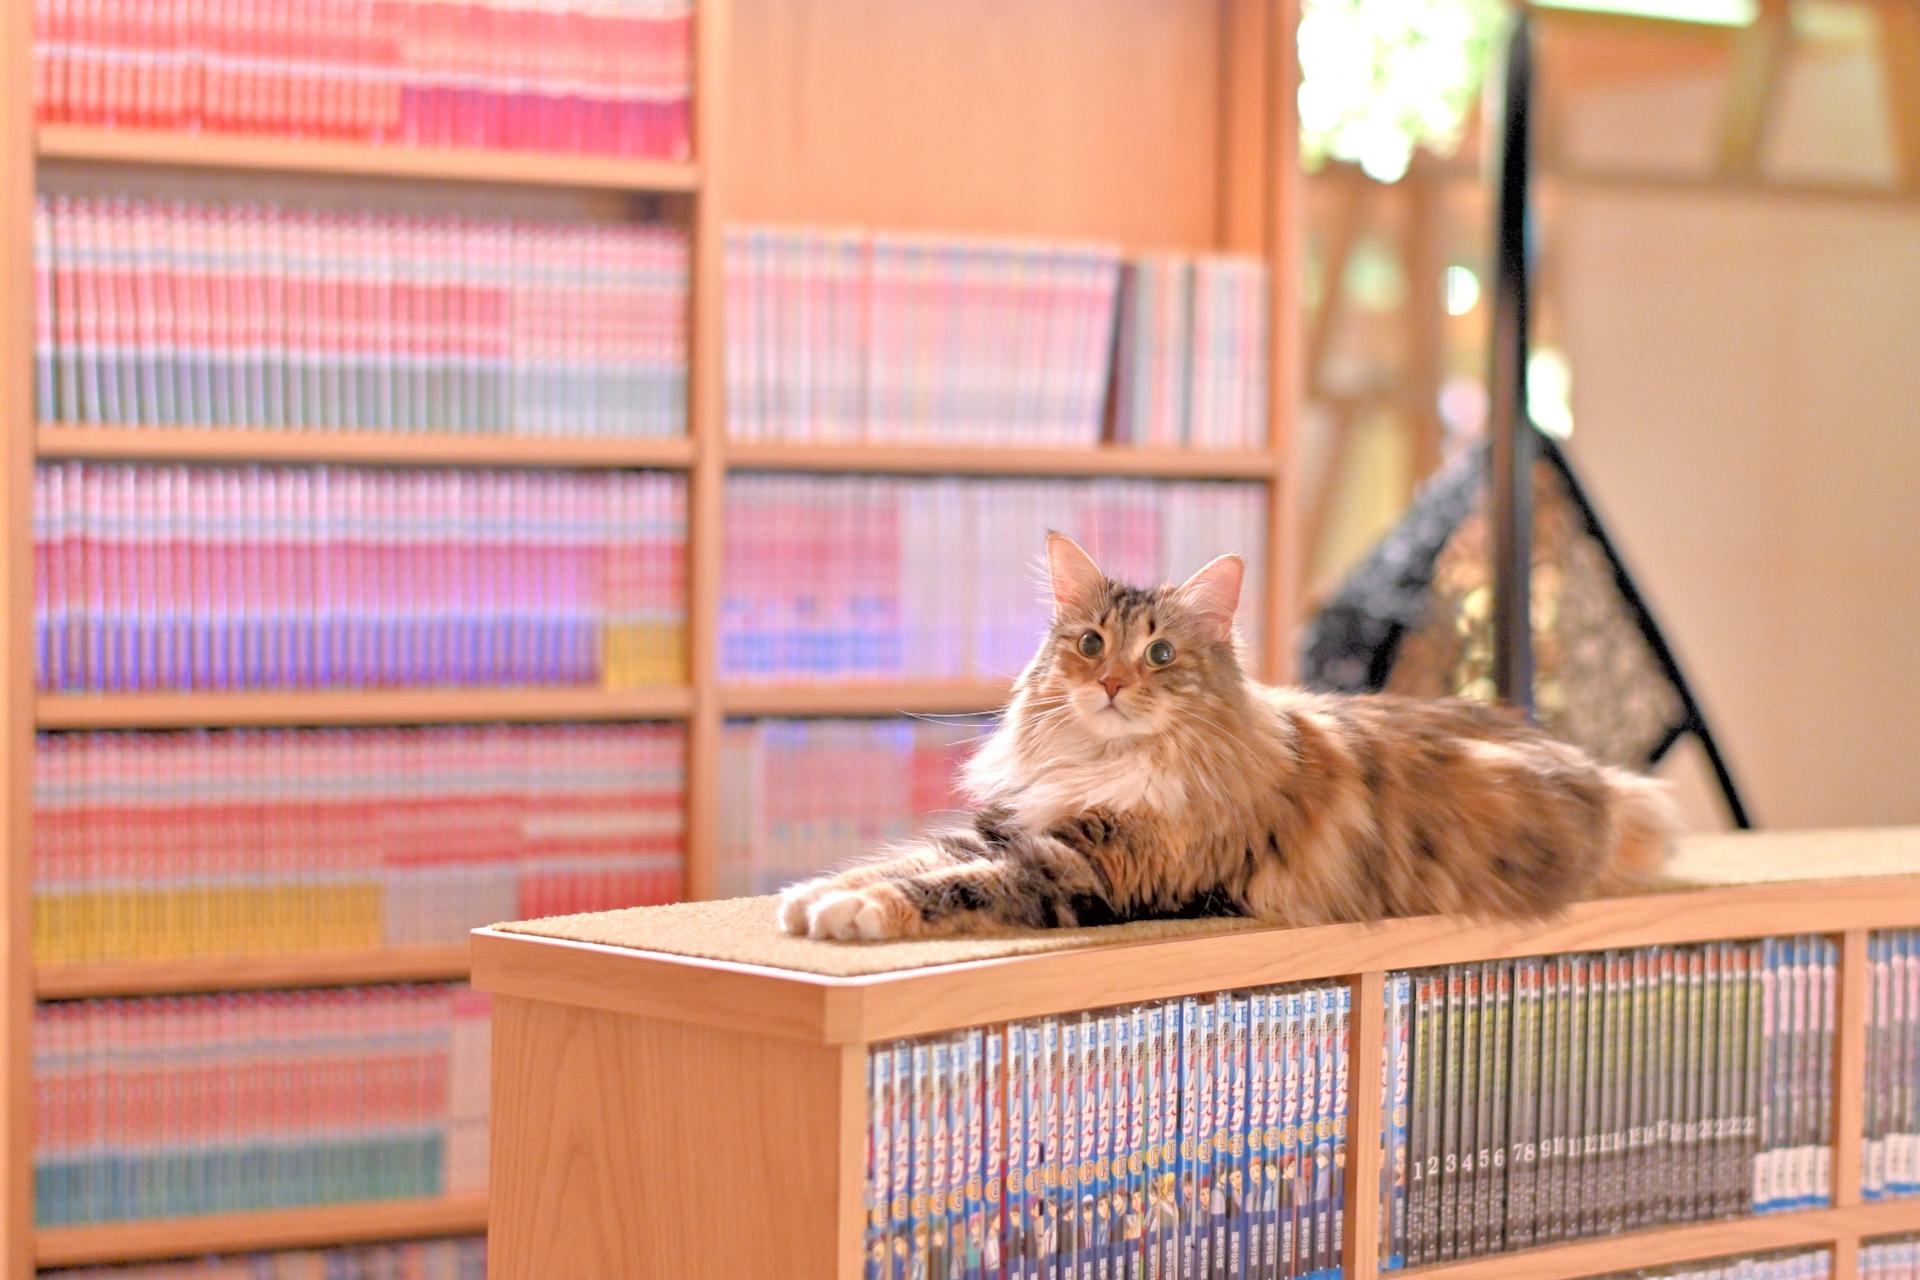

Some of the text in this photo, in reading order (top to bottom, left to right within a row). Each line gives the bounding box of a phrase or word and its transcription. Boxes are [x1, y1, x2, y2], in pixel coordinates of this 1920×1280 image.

[1494, 1147, 1504, 1166] 6
[1512, 1143, 1521, 1161] 7
[1523, 1143, 1535, 1162] 8
[1541, 1138, 1551, 1158] 9
[1428, 1156, 1439, 1175] 2
[1446, 1153, 1457, 1172] 3
[1462, 1153, 1473, 1172] 4
[1478, 1148, 1489, 1168] 5
[1414, 1161, 1423, 1180] 1
